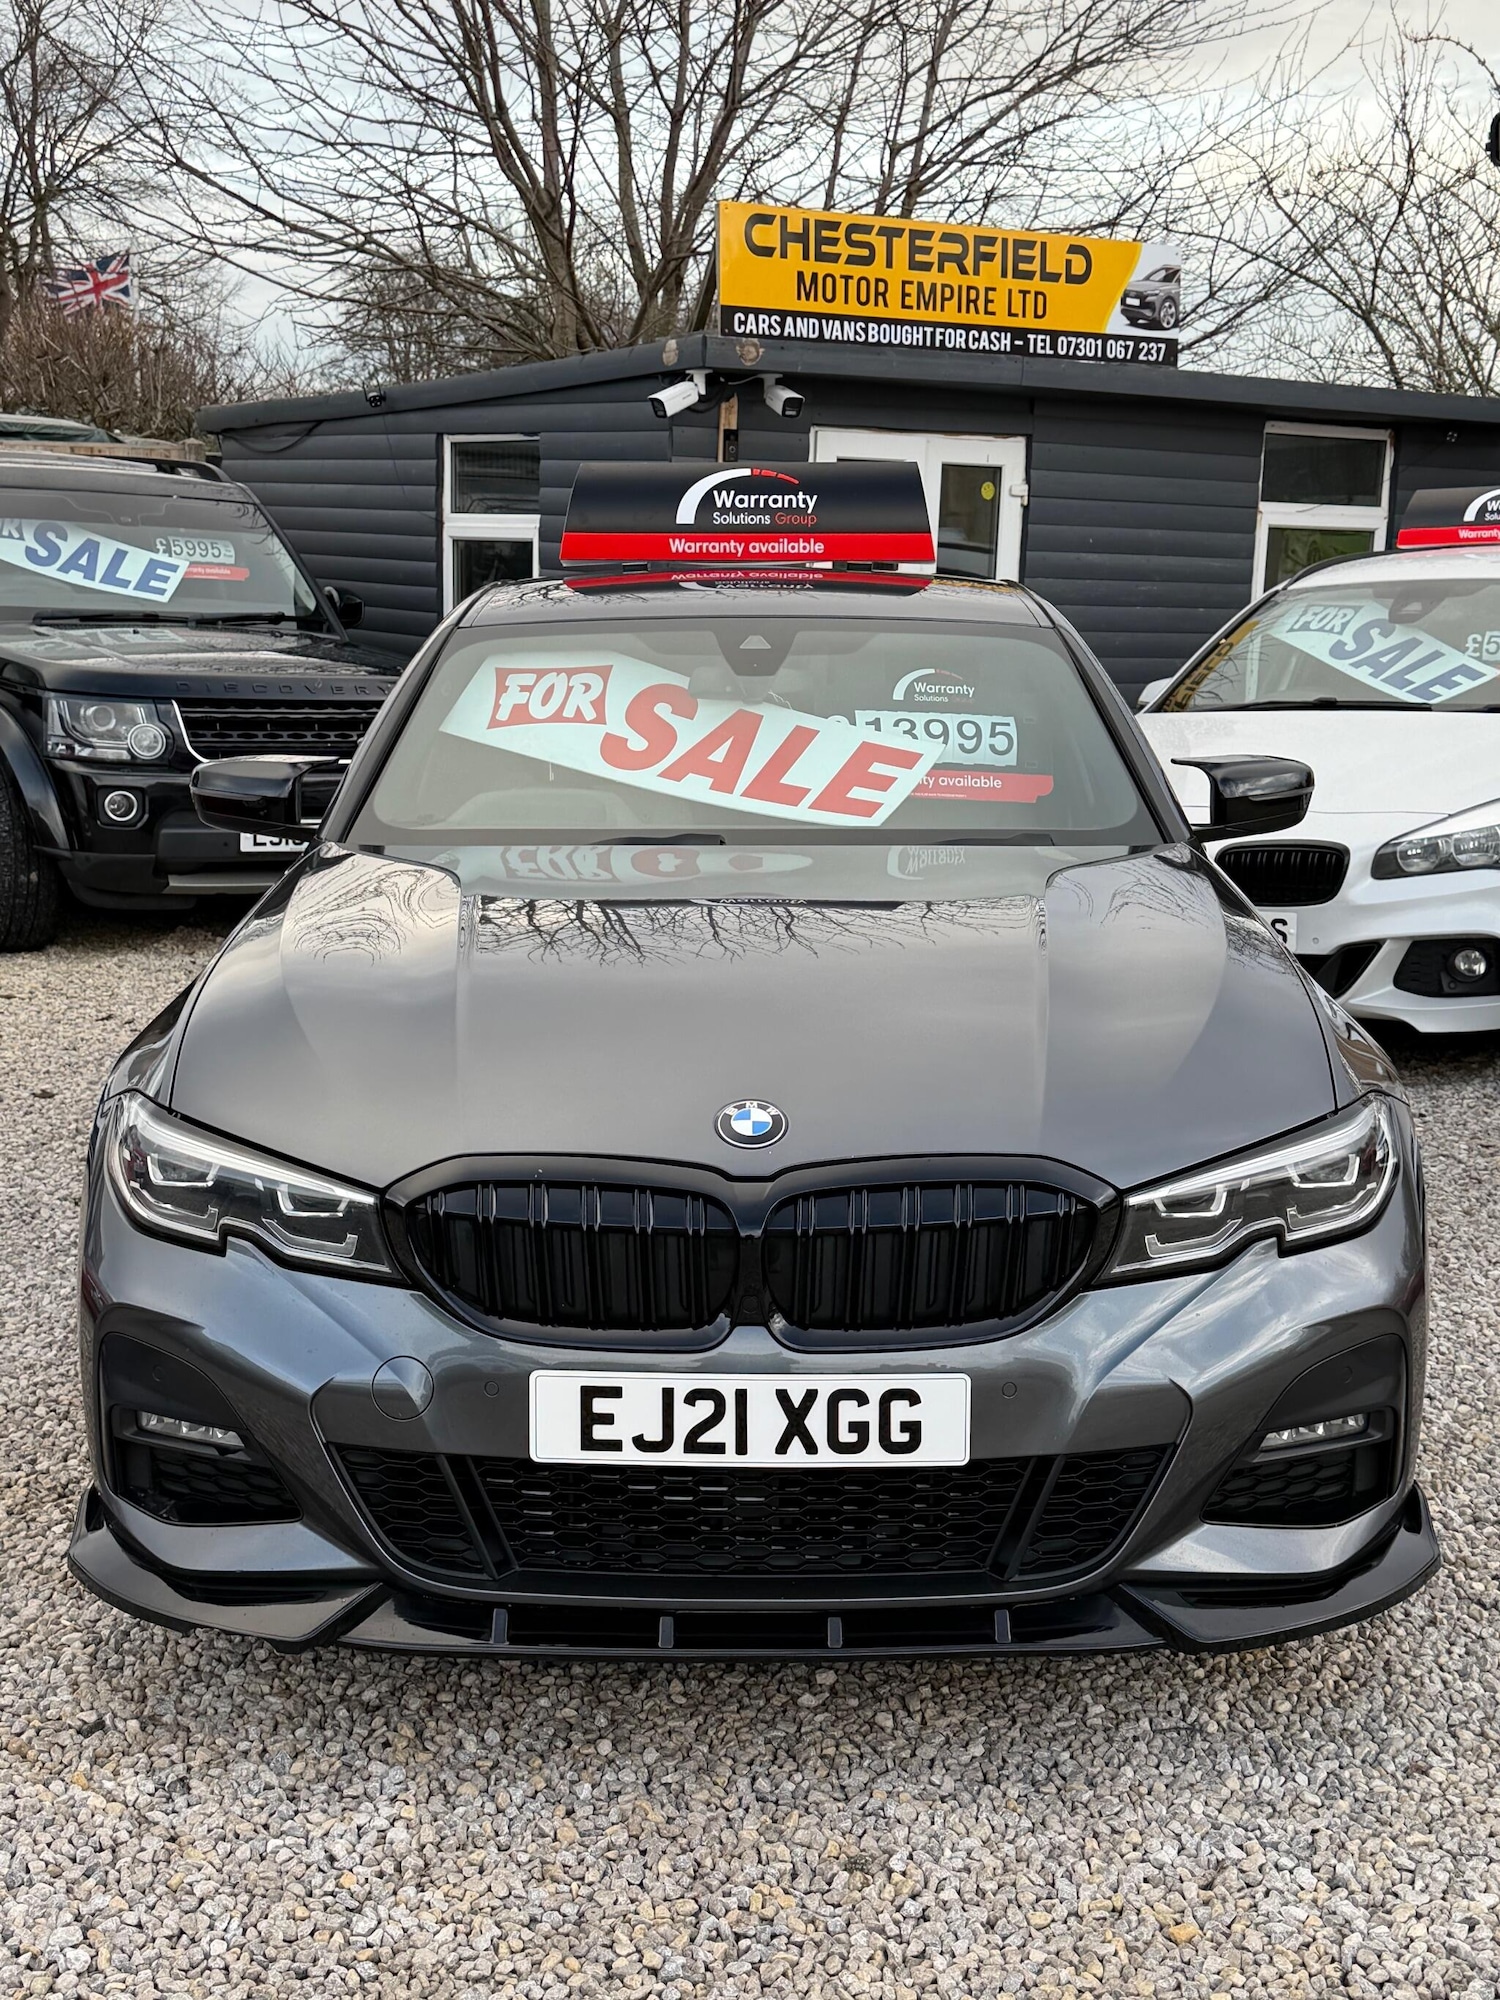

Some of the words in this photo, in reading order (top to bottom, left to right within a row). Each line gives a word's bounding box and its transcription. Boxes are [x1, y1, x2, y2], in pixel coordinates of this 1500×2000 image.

[744, 212, 1093, 285] CHESTERFIELD
[796, 270, 889, 308] MOTOR
[900, 279, 997, 316] EMPIRE
[1006, 287, 1048, 320] LTD
[733, 312, 781, 336] CARS
[783, 316, 820, 339] AND
[821, 318, 867, 343] VANS
[867, 322, 934, 347] BOUGHT
[935, 327, 967, 350] FOR
[968, 329, 1011, 352] CASH
[1027, 334, 1055, 355] TEL
[1057, 335, 1102, 358] 07301
[1106, 339, 1135, 361] 067
[1138, 341, 1167, 362] 237
[712, 490, 818, 514] Warranty
[712, 511, 771, 525] Solutions
[774, 512, 818, 527] Group
[25, 522, 180, 596] SALE
[155, 537, 222, 559] £5995
[669, 537, 746, 558] Warranty
[748, 537, 825, 554] available
[1292, 605, 1352, 633] FOR
[1329, 617, 1487, 701] SALE
[913, 681, 975, 698] Warranty
[913, 694, 949, 702] Solutions
[495, 671, 605, 724] FOR
[599, 682, 925, 819] SALE
[827, 716, 1015, 756] 3995
[938, 774, 1003, 788] available
[725, 1101, 779, 1115] BMW
[579, 1385, 748, 1456] EJ21
[774, 1387, 923, 1456] XGG
